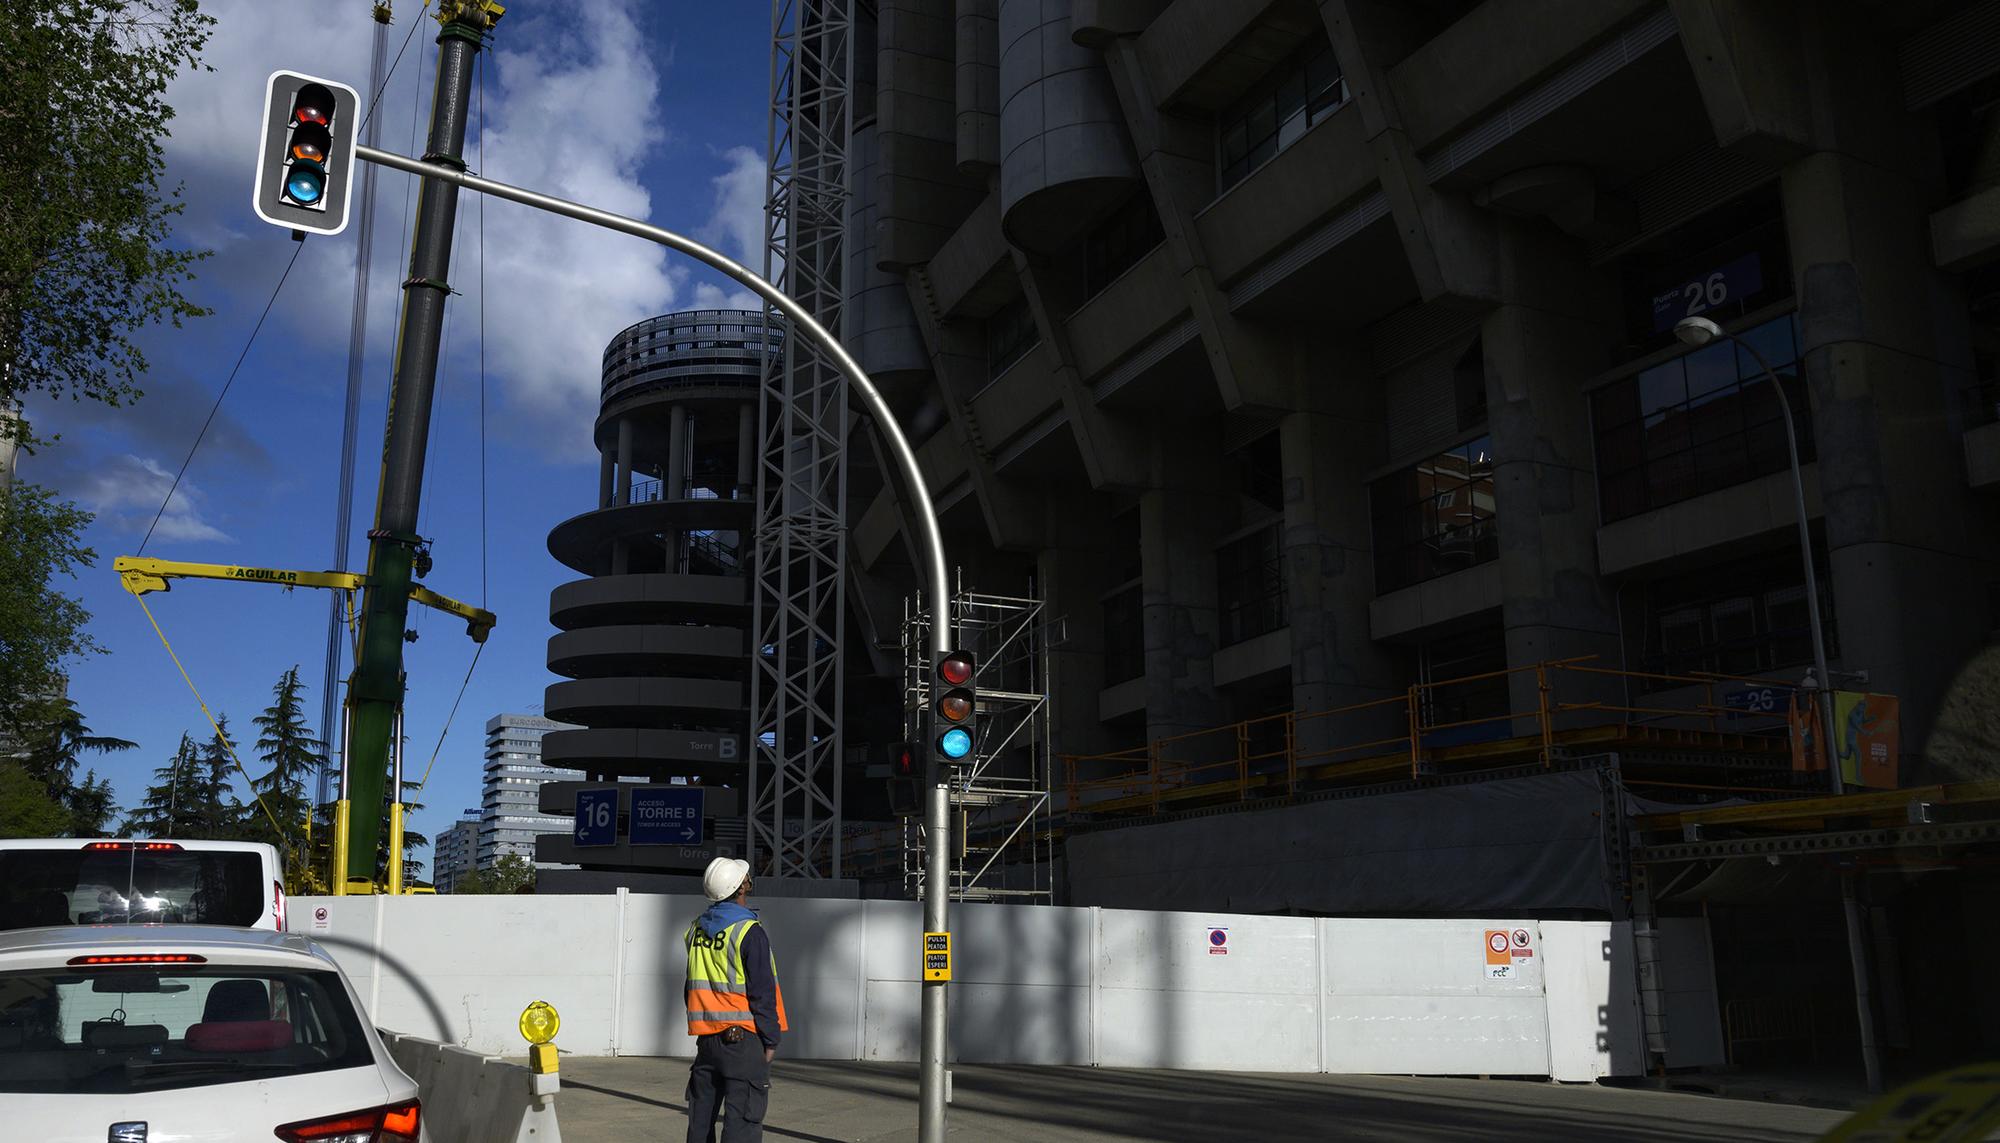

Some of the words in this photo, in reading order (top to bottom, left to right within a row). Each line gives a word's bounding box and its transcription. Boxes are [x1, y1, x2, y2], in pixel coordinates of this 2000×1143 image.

[1684, 272, 1728, 316] 26
[235, 568, 297, 581] AGUILAR
[1747, 688, 1775, 713] 26
[688, 741, 714, 750] Torre
[719, 737, 737, 759] B
[585, 801, 610, 828] 16
[638, 807, 683, 819] TORRE
[686, 807, 696, 819] B
[679, 847, 710, 860] Torre
